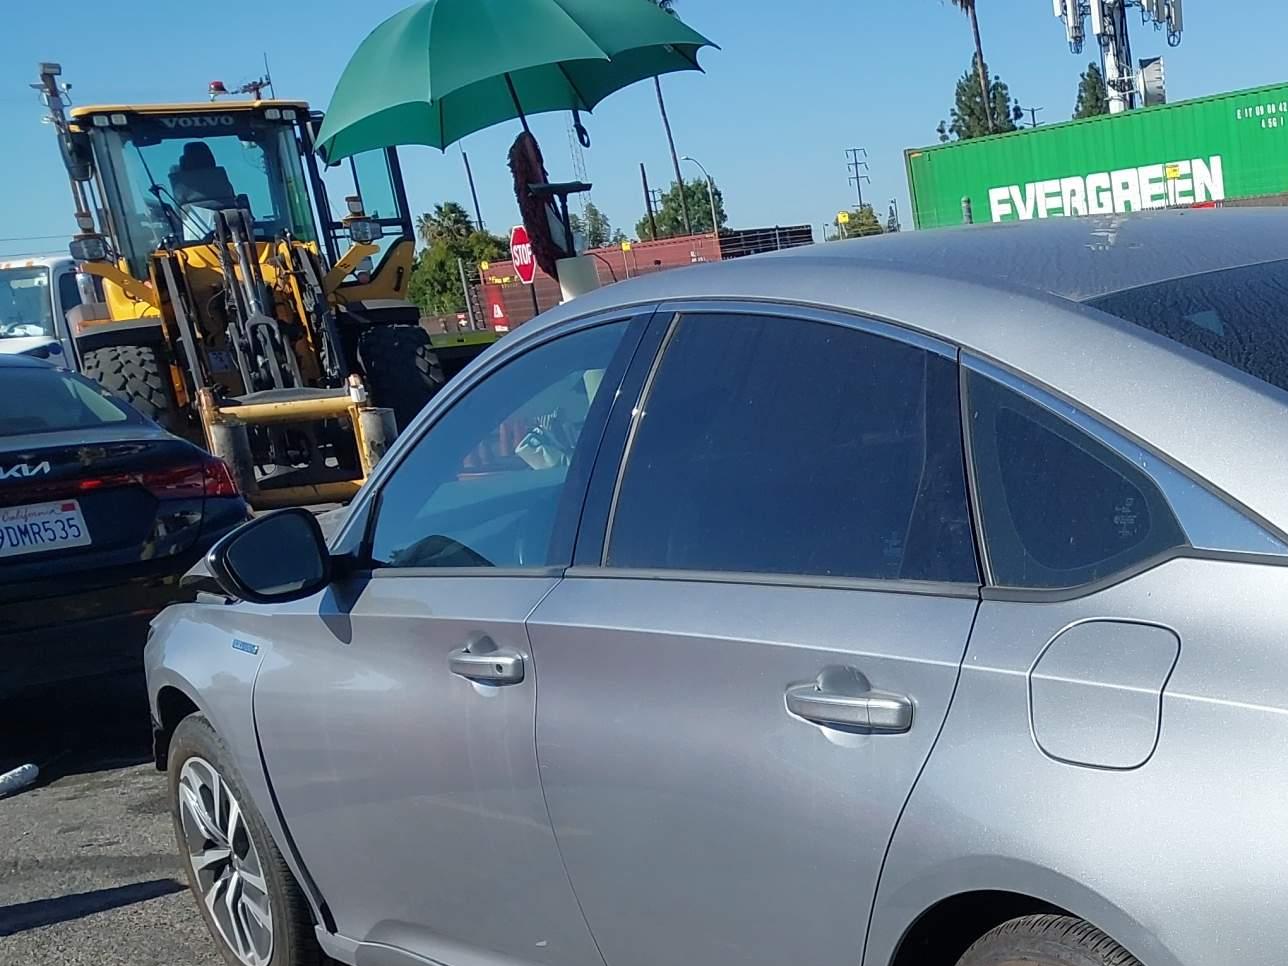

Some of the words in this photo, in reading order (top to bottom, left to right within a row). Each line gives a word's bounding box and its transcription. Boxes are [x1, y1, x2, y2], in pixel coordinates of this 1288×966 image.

[160, 115, 235, 128] VOLVO
[988, 155, 1224, 223] EVERGREEN
[513, 243, 532, 266] STOP
